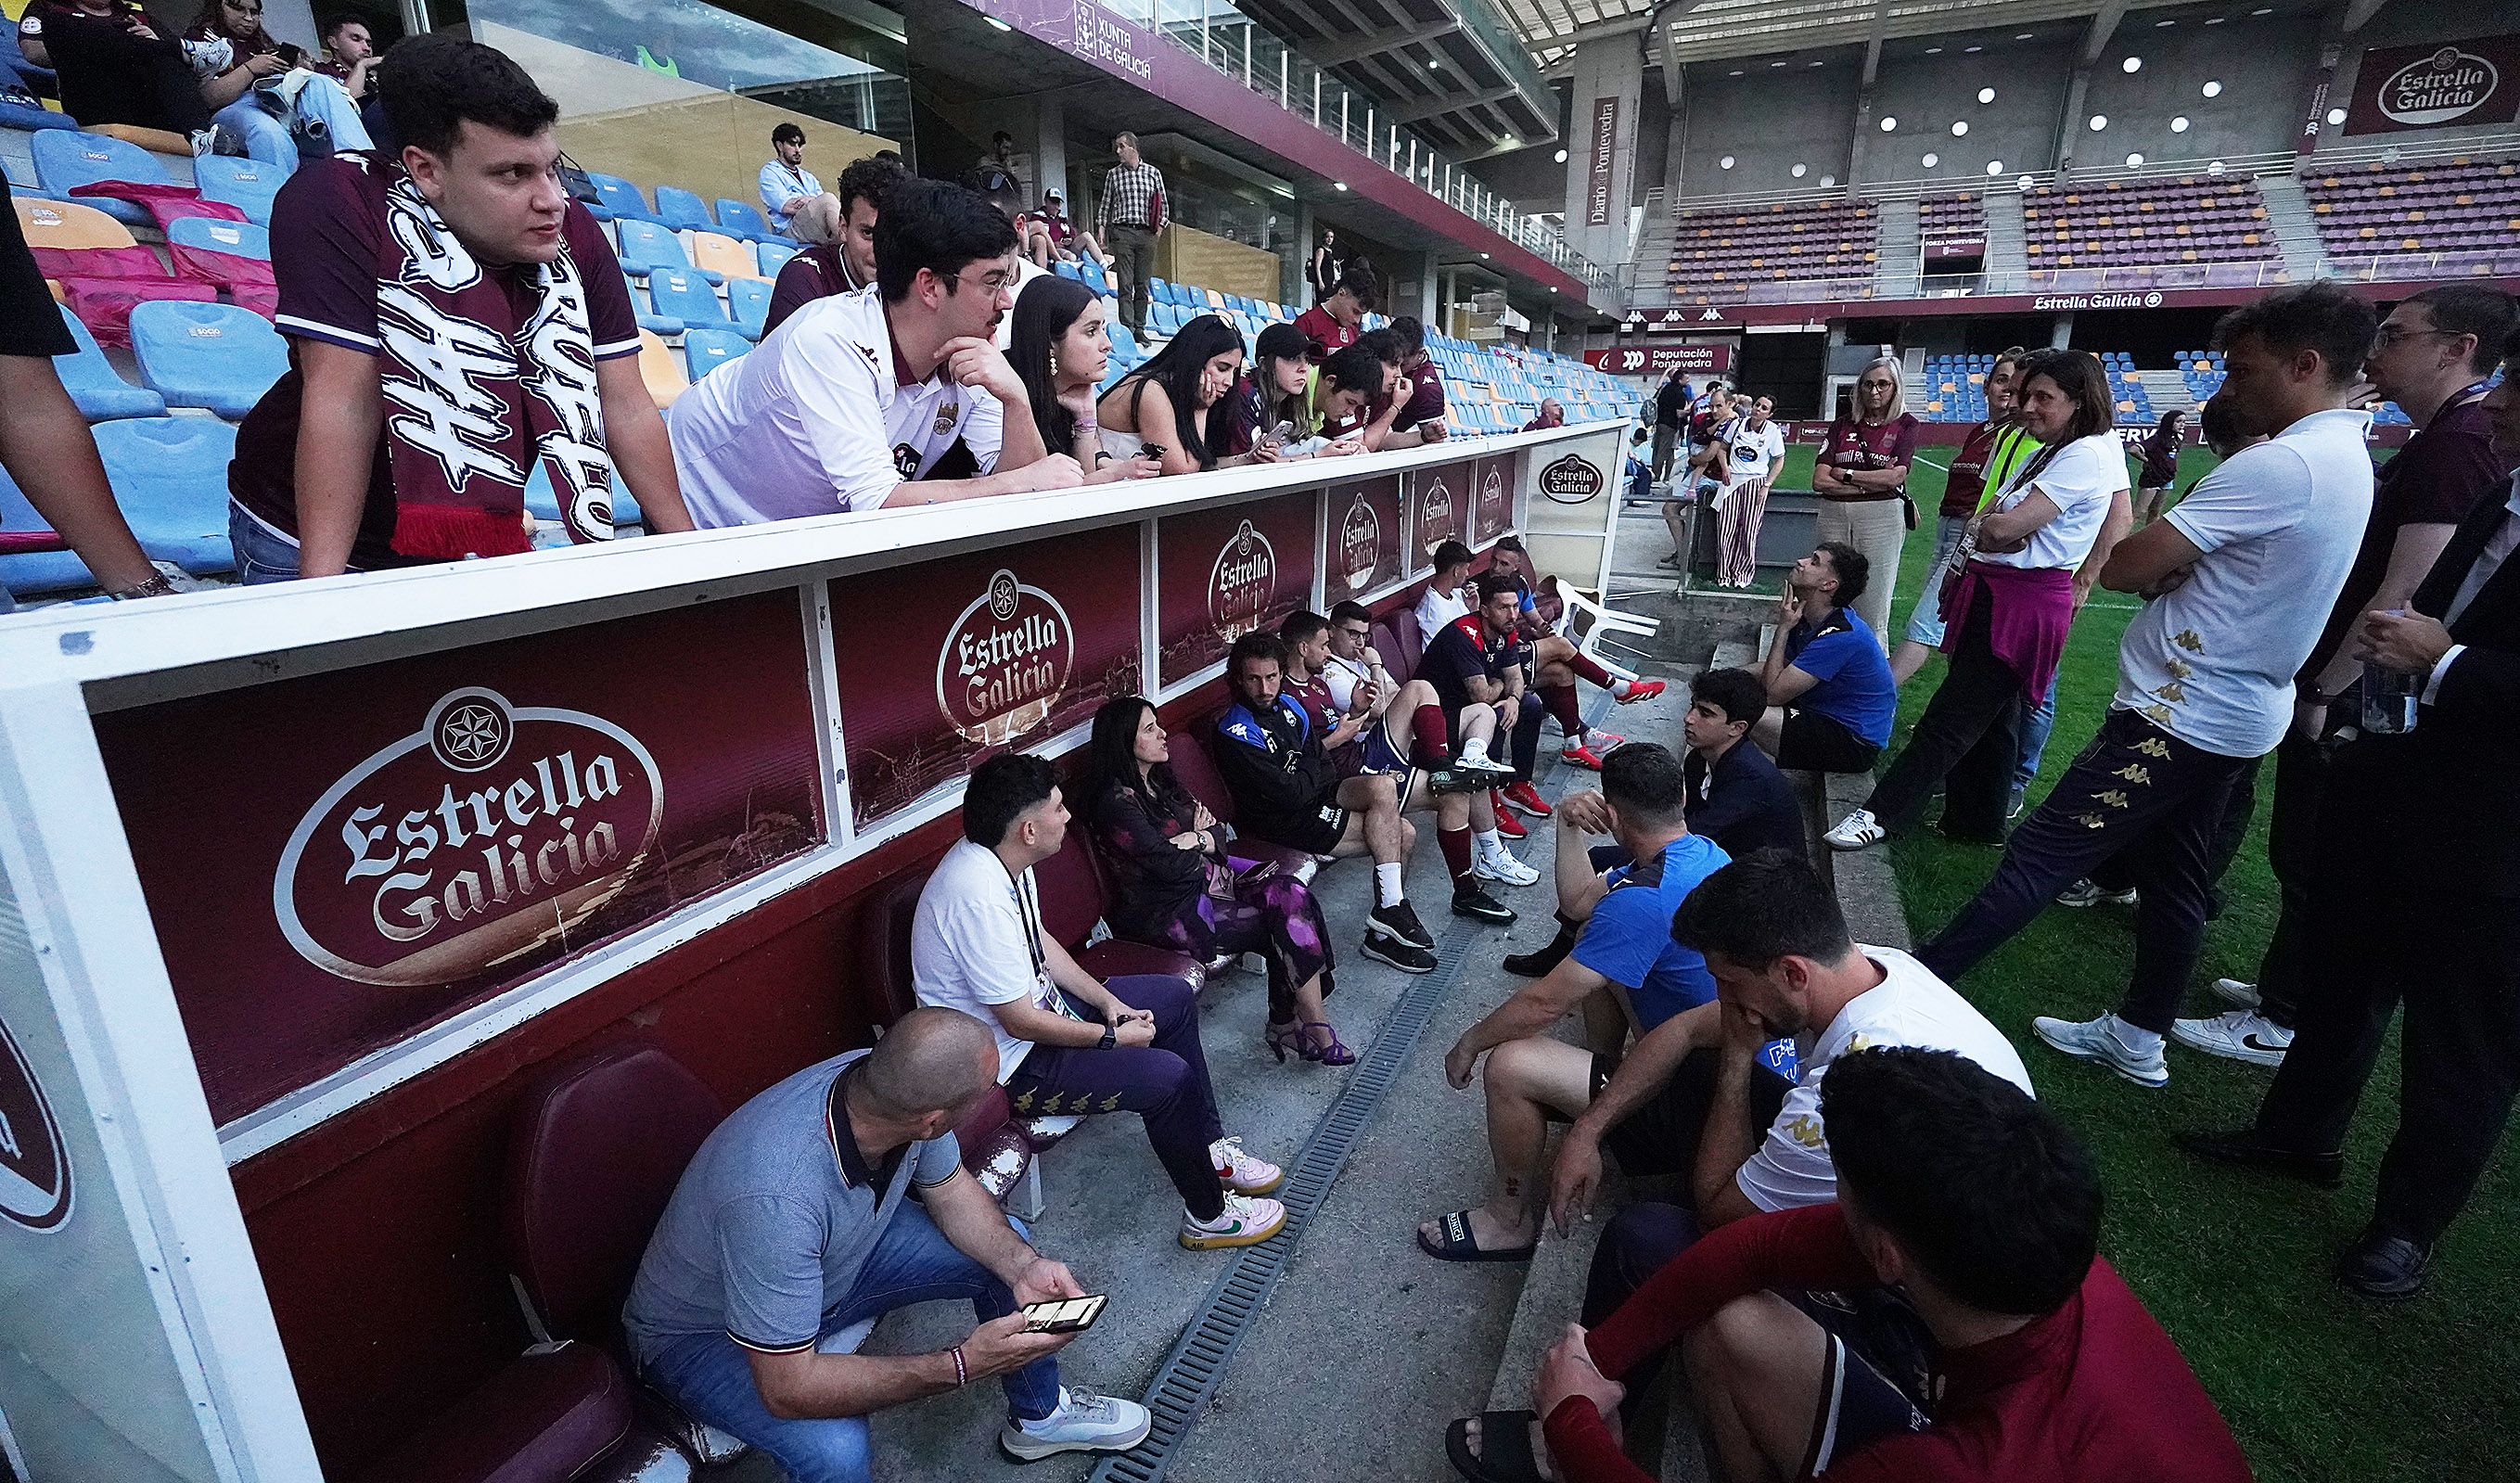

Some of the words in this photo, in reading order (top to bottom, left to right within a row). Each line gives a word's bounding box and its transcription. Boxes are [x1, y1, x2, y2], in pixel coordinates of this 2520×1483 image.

[1098, 17, 1131, 49] XUNTA
[1098, 39, 1112, 60] DE
[1114, 47, 1150, 80] GALICIA
[2397, 68, 2484, 91] Estrella
[2397, 86, 2474, 109] Galicia
[1595, 104, 1614, 173] Pontevedra
[1592, 186, 1606, 223] Diario
[2033, 296, 2087, 310] Estrella
[2091, 294, 2141, 308] Galicia
[1652, 349, 1713, 361] Deputación
[1652, 359, 1712, 368] Pontevedra
[1551, 469, 1593, 482] Estrella
[1552, 480, 1591, 492] Galicia
[1426, 499, 1449, 522] Estrella
[1346, 520, 1375, 548] Estrella
[1219, 553, 1268, 592] Estrella
[959, 614, 1057, 677] Estrella
[966, 655, 1055, 717] Galicia
[341, 750, 622, 884] Estrella
[374, 817, 621, 941] Galicia
